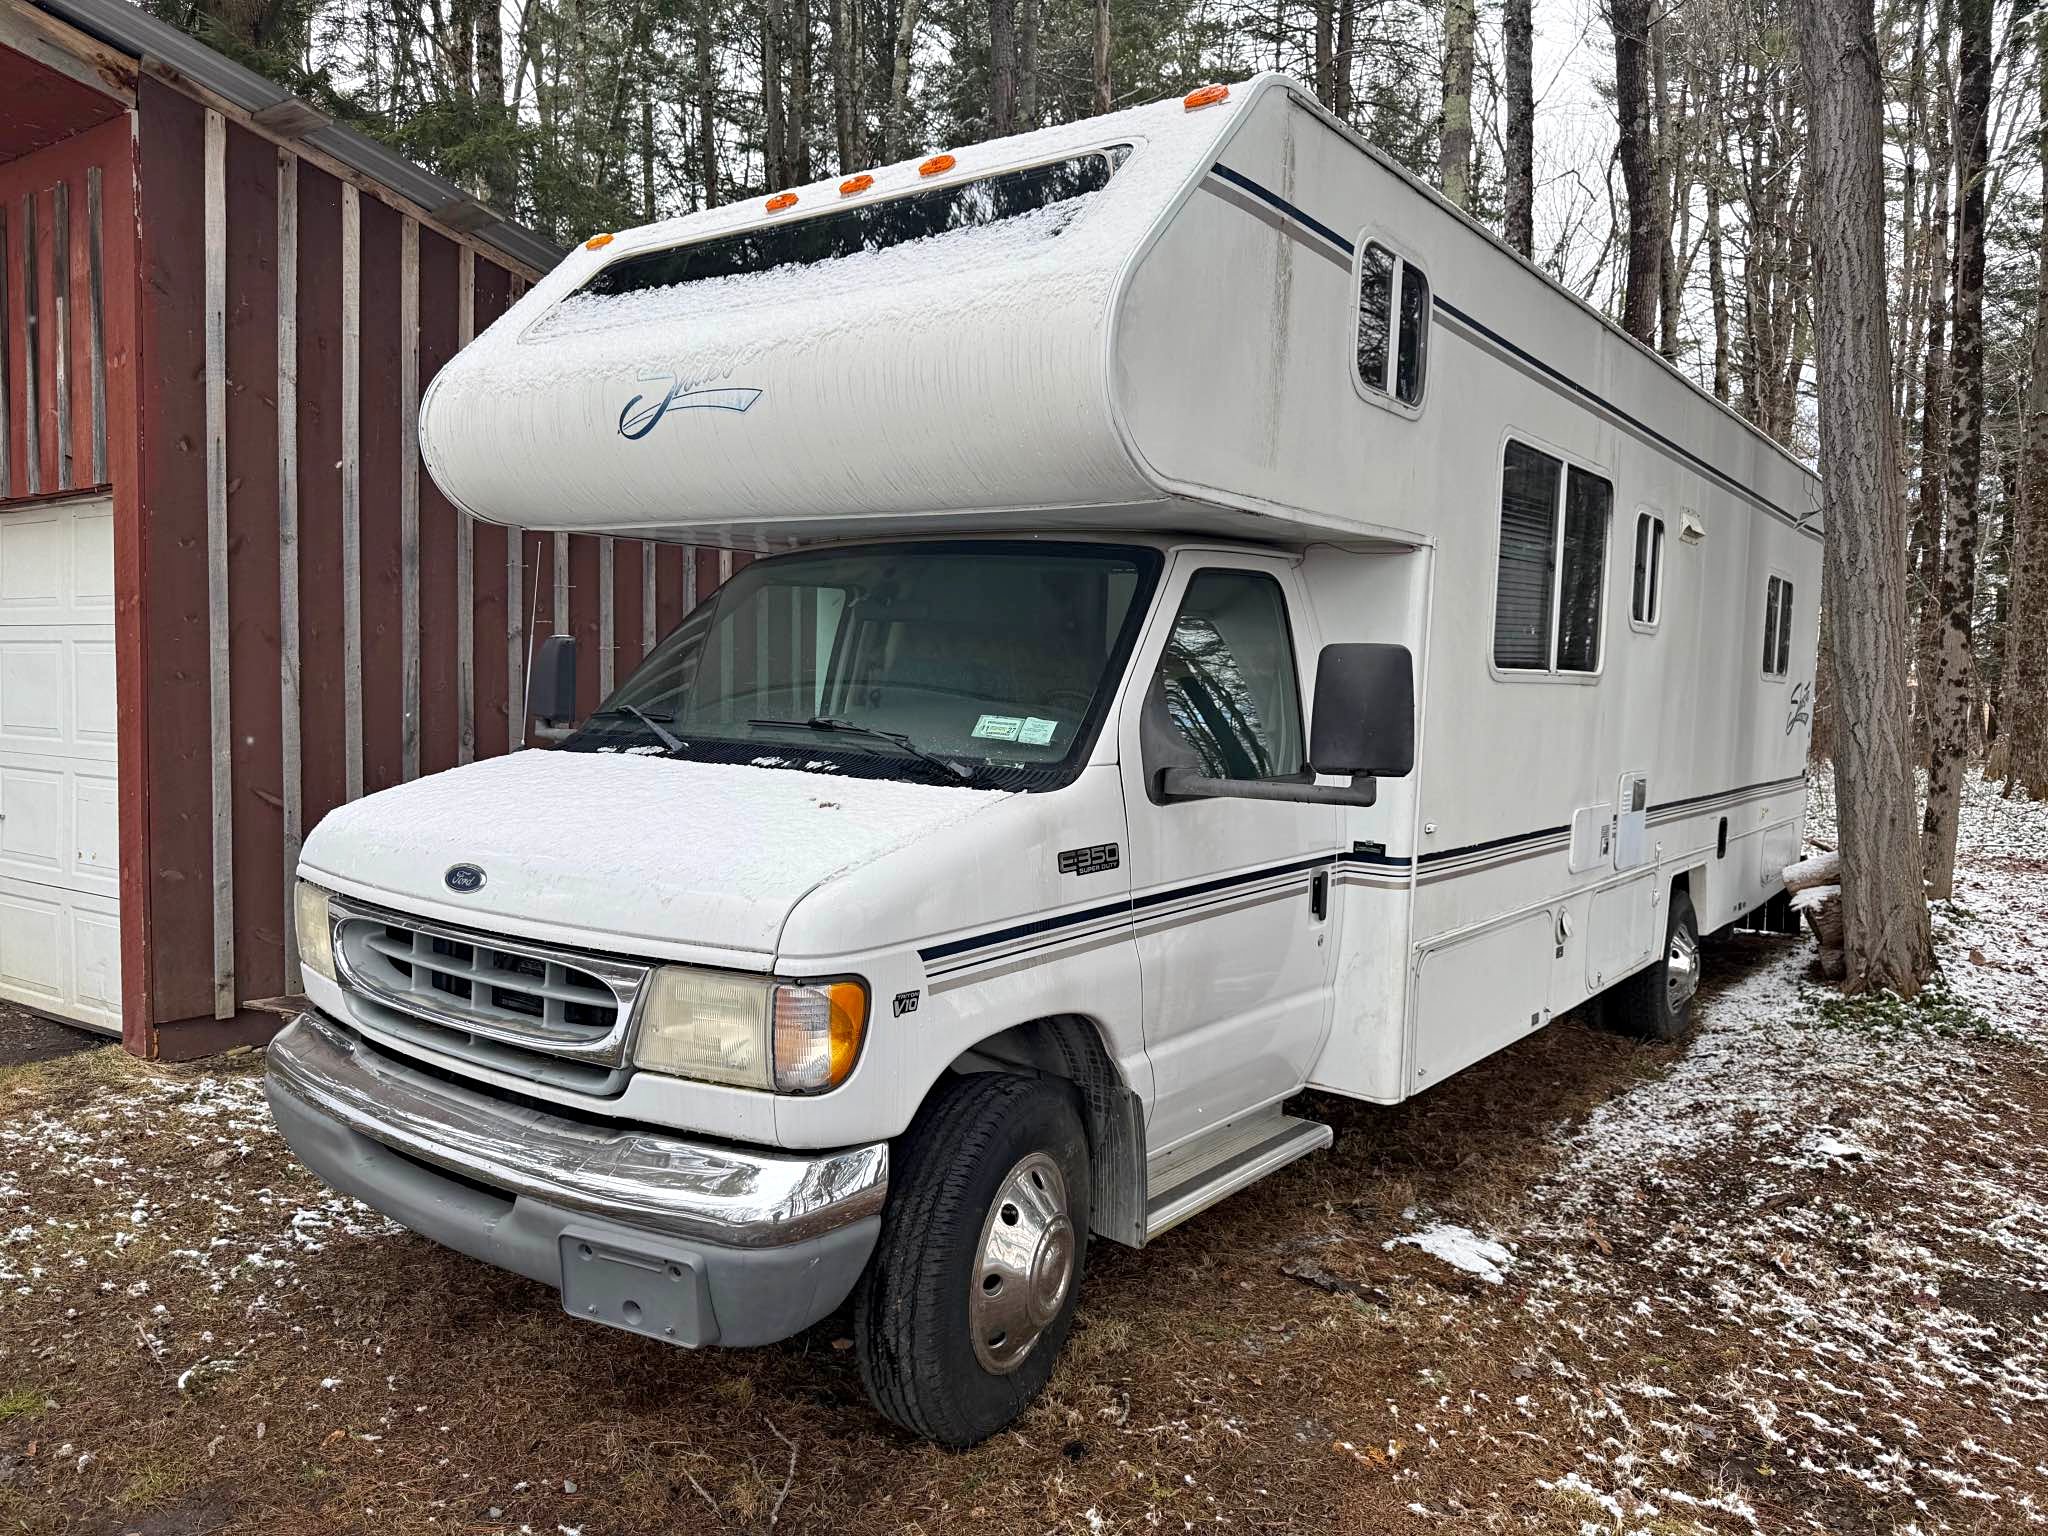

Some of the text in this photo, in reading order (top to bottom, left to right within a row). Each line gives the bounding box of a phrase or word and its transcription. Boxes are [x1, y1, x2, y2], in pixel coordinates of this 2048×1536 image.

[1079, 861, 1118, 874] SUPER DUTY
[451, 870, 476, 886] Ford
[893, 998, 918, 1017] V10
